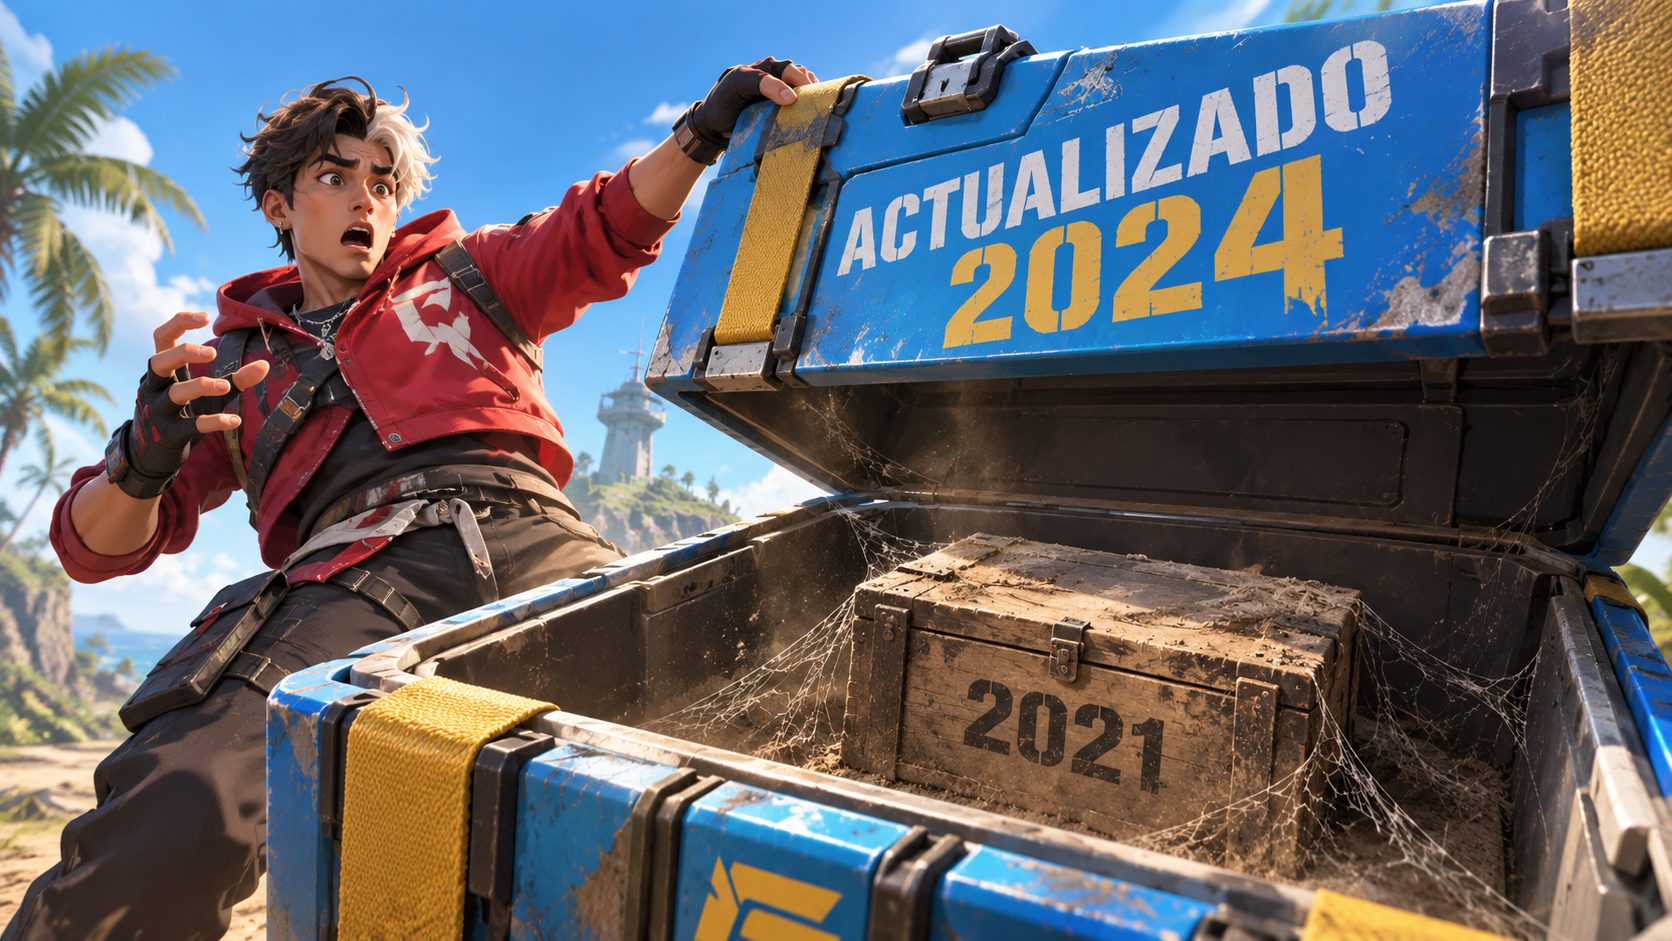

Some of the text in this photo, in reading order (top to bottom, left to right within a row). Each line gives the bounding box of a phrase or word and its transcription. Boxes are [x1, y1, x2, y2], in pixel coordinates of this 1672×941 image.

[837, 40, 1392, 276] ACTUALIZADO
[943, 154, 1343, 348] 2024
[963, 679, 1165, 795] 2021
